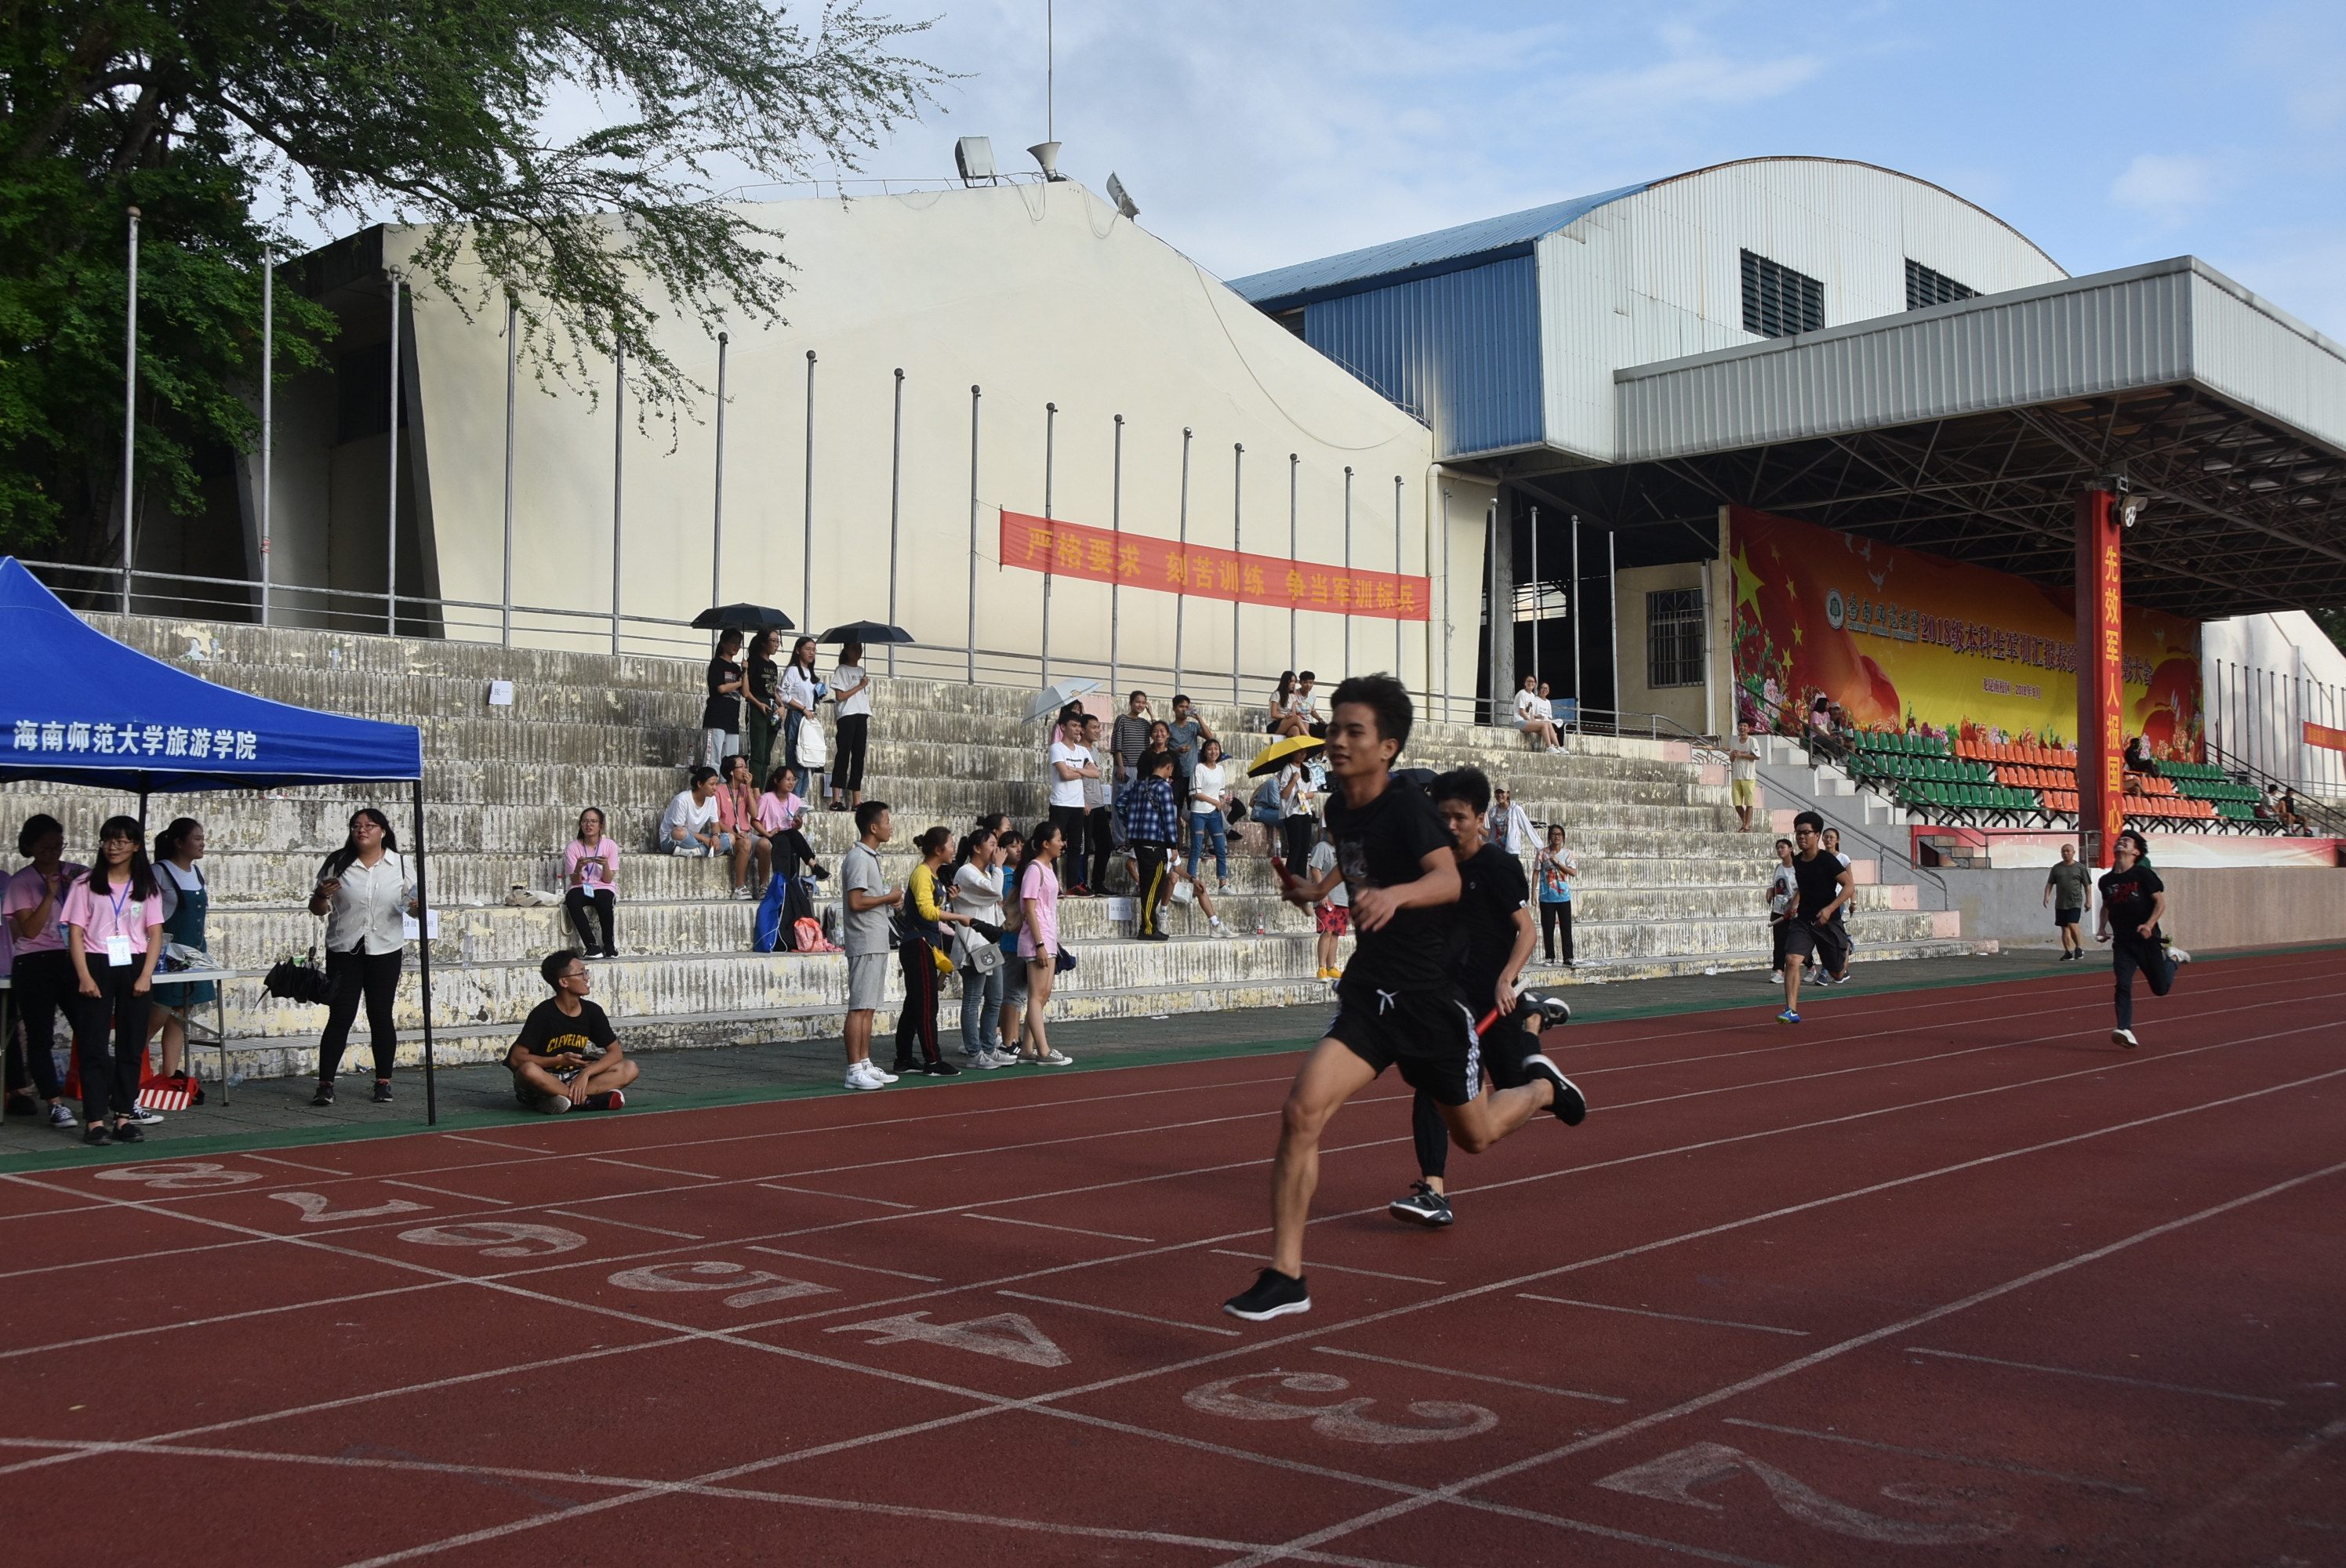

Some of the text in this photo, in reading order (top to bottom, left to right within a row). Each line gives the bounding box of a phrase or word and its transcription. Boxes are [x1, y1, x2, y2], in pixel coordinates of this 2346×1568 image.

[1026, 527, 1416, 613] 严格要求 刻苦训练 争当军训标兵
[2104, 545, 2123, 834] 先效军人报国心
[13, 720, 257, 760] 海南师范大学旅游学院
[547, 1033, 589, 1053] CLEVELAN
[93, 1161, 263, 1188] 8
[267, 1192, 434, 1222] 7
[396, 1221, 588, 1258] 6
[606, 1261, 842, 1308] 5
[822, 1310, 1073, 1368] 4
[1181, 1370, 1500, 1444] 3
[1592, 1441, 2021, 1545] 2
